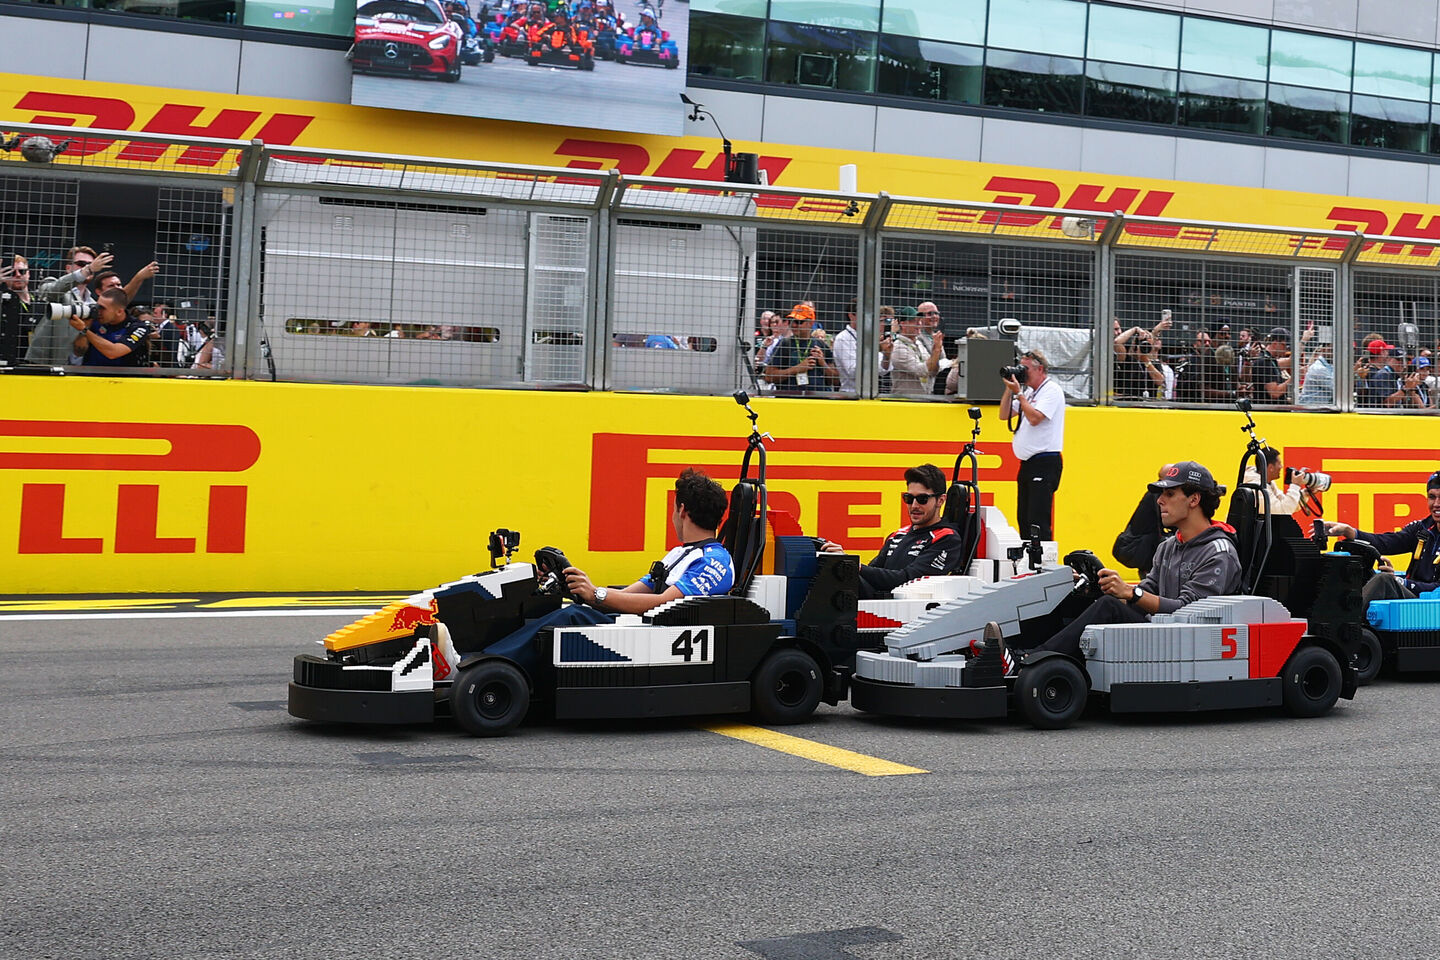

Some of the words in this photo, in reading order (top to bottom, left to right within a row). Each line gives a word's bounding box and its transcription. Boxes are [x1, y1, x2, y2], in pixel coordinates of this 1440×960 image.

[8, 91, 328, 167] DHL
[977, 176, 1182, 239] DHL
[710, 557, 727, 577] VISA
[671, 629, 709, 662] 41
[1221, 627, 1238, 659] 5
